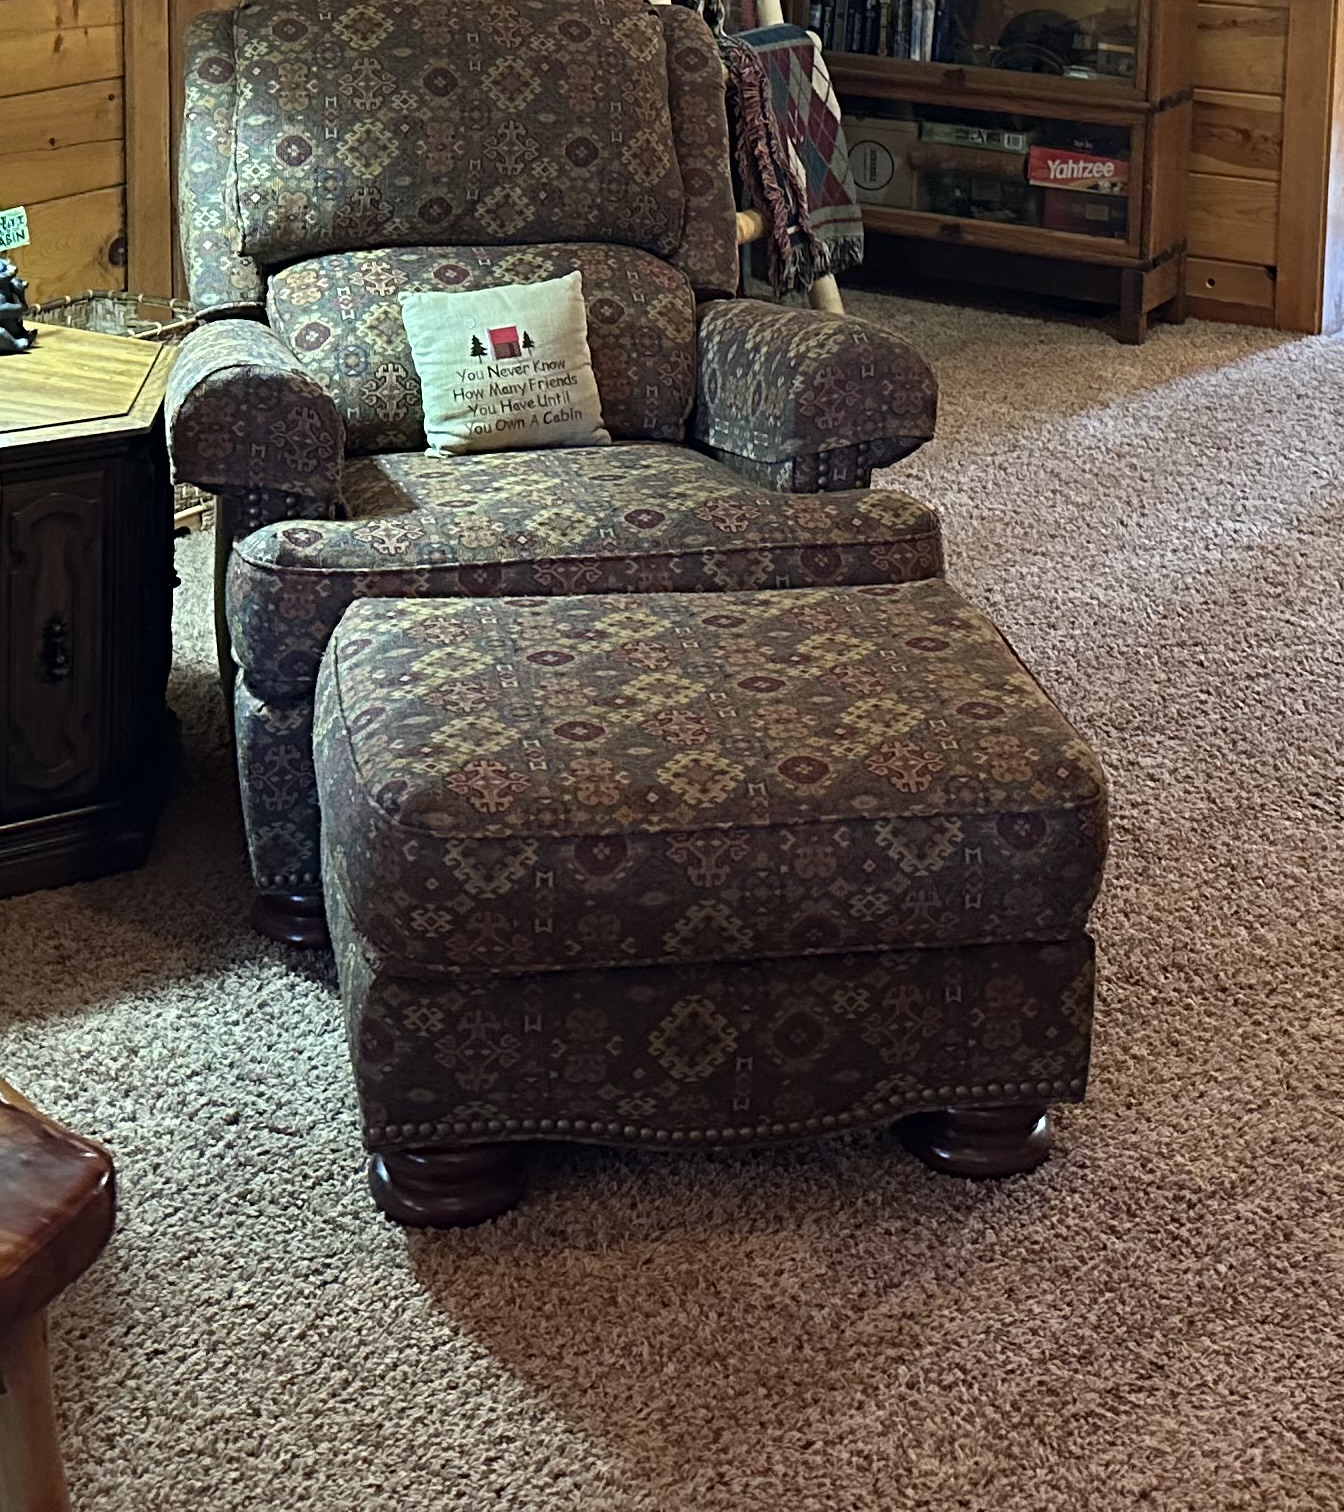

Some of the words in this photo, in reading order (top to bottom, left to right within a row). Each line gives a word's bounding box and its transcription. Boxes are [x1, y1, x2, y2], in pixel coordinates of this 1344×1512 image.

[1047, 159, 1115, 179] Yahtzee
[456, 368, 485, 383] You
[487, 364, 530, 378] Never
[532, 359, 566, 372] Know
[453, 388, 484, 402] How
[489, 382, 527, 397] Many
[528, 372, 578, 391] Friends
[468, 404, 496, 417] You
[500, 399, 535, 413] Have
[537, 391, 570, 408] Until
[465, 423, 492, 436] You
[495, 419, 525, 432] Own
[530, 414, 539, 426] A
[543, 408, 583, 424] Cabin
